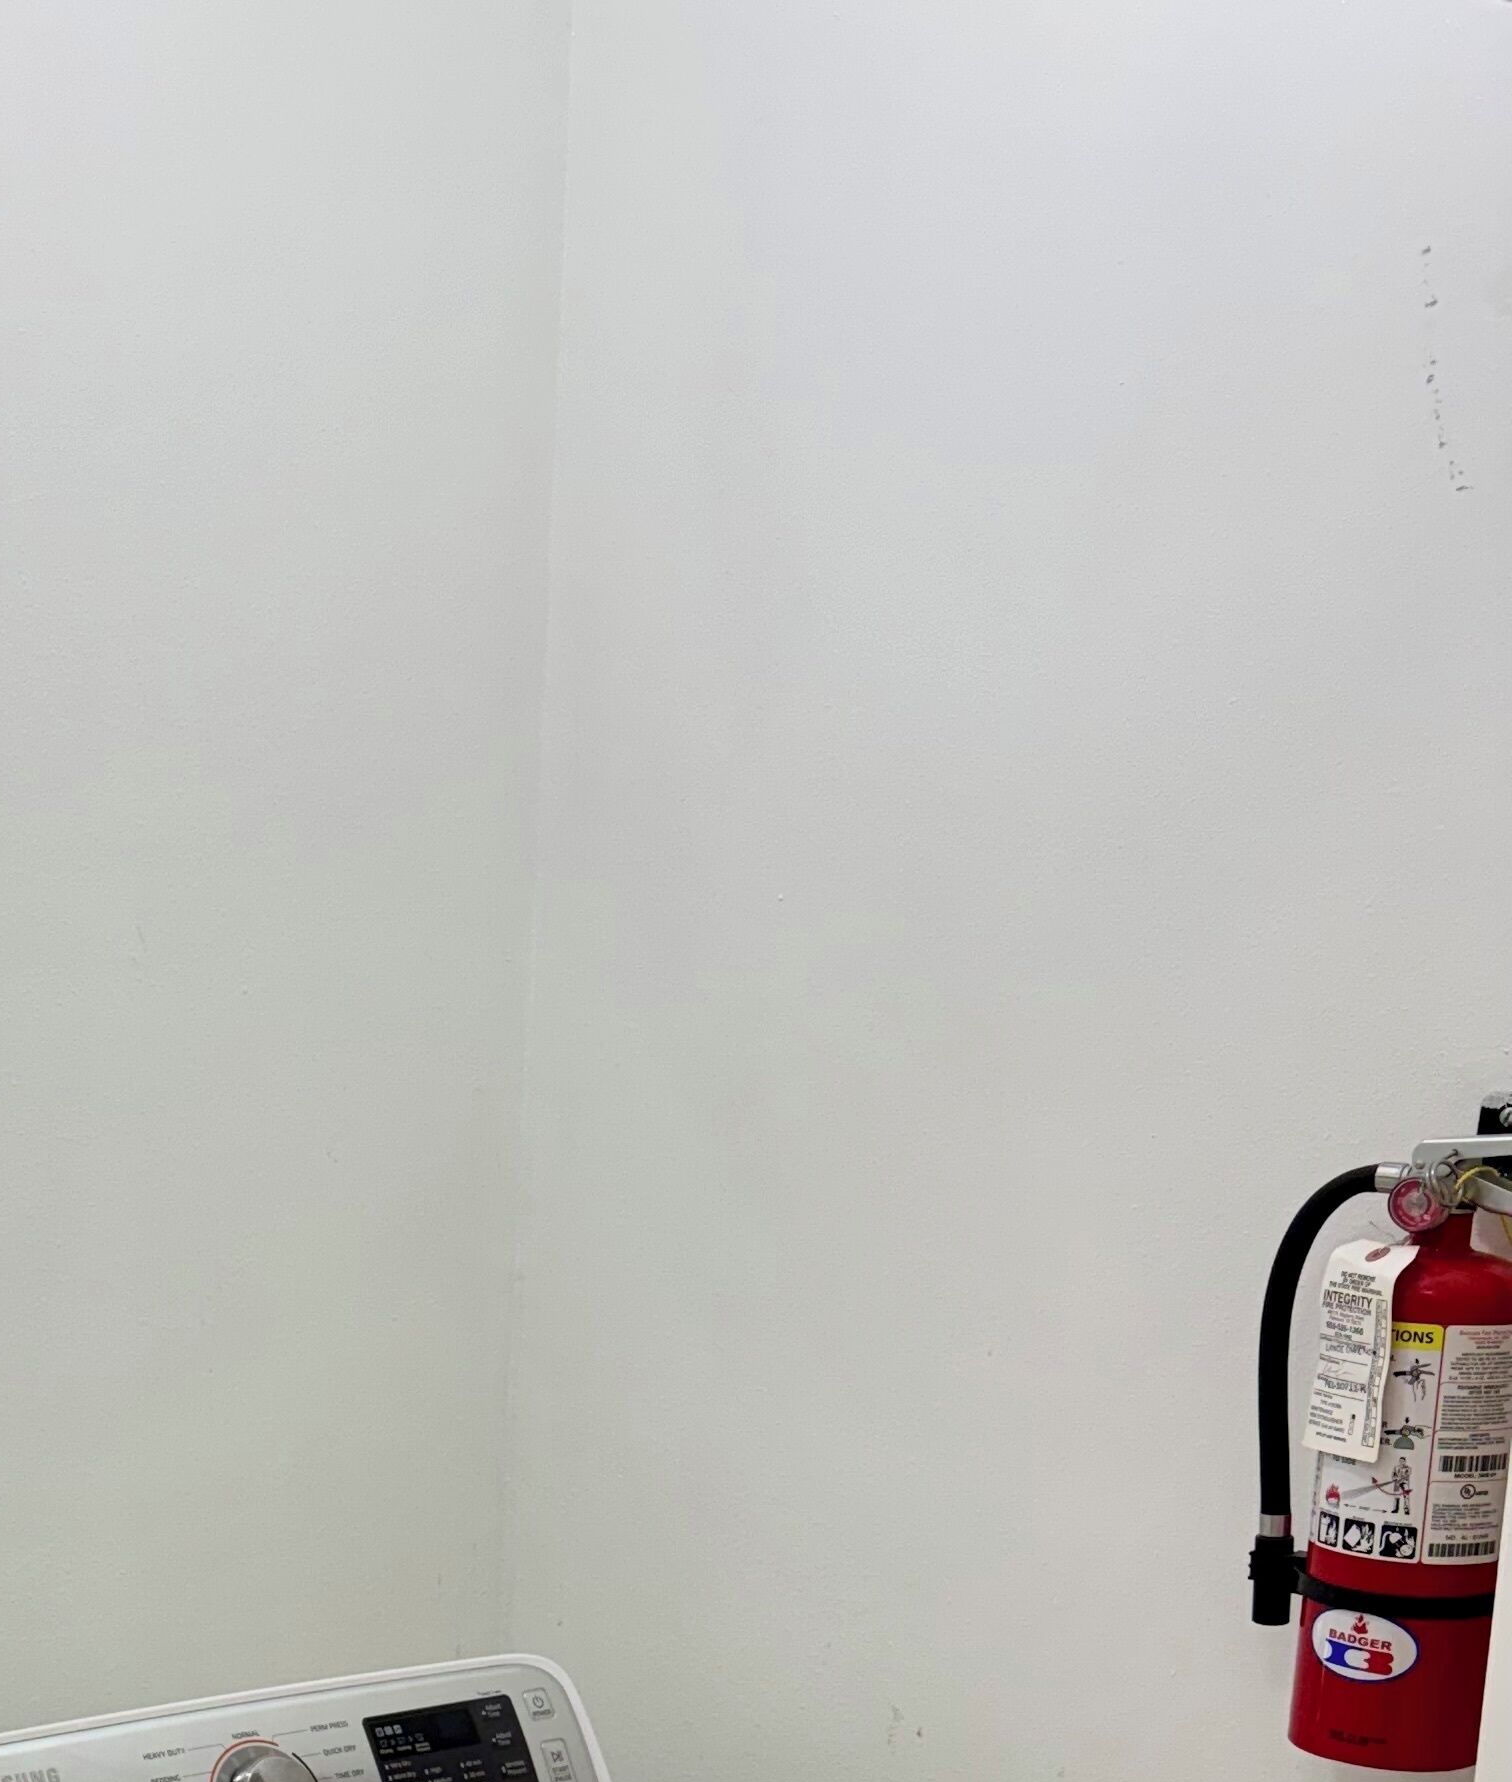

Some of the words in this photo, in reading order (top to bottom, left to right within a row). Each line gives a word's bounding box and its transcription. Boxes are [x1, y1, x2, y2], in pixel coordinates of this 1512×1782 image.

[1323, 1289, 1373, 1309] INTEGRITY
[1328, 1628, 1392, 1651] BADGER
[232, 1730, 260, 1740] NORMAL
[143, 1750, 166, 1761] HEAVY
[167, 1747, 186, 1758] DUTY
